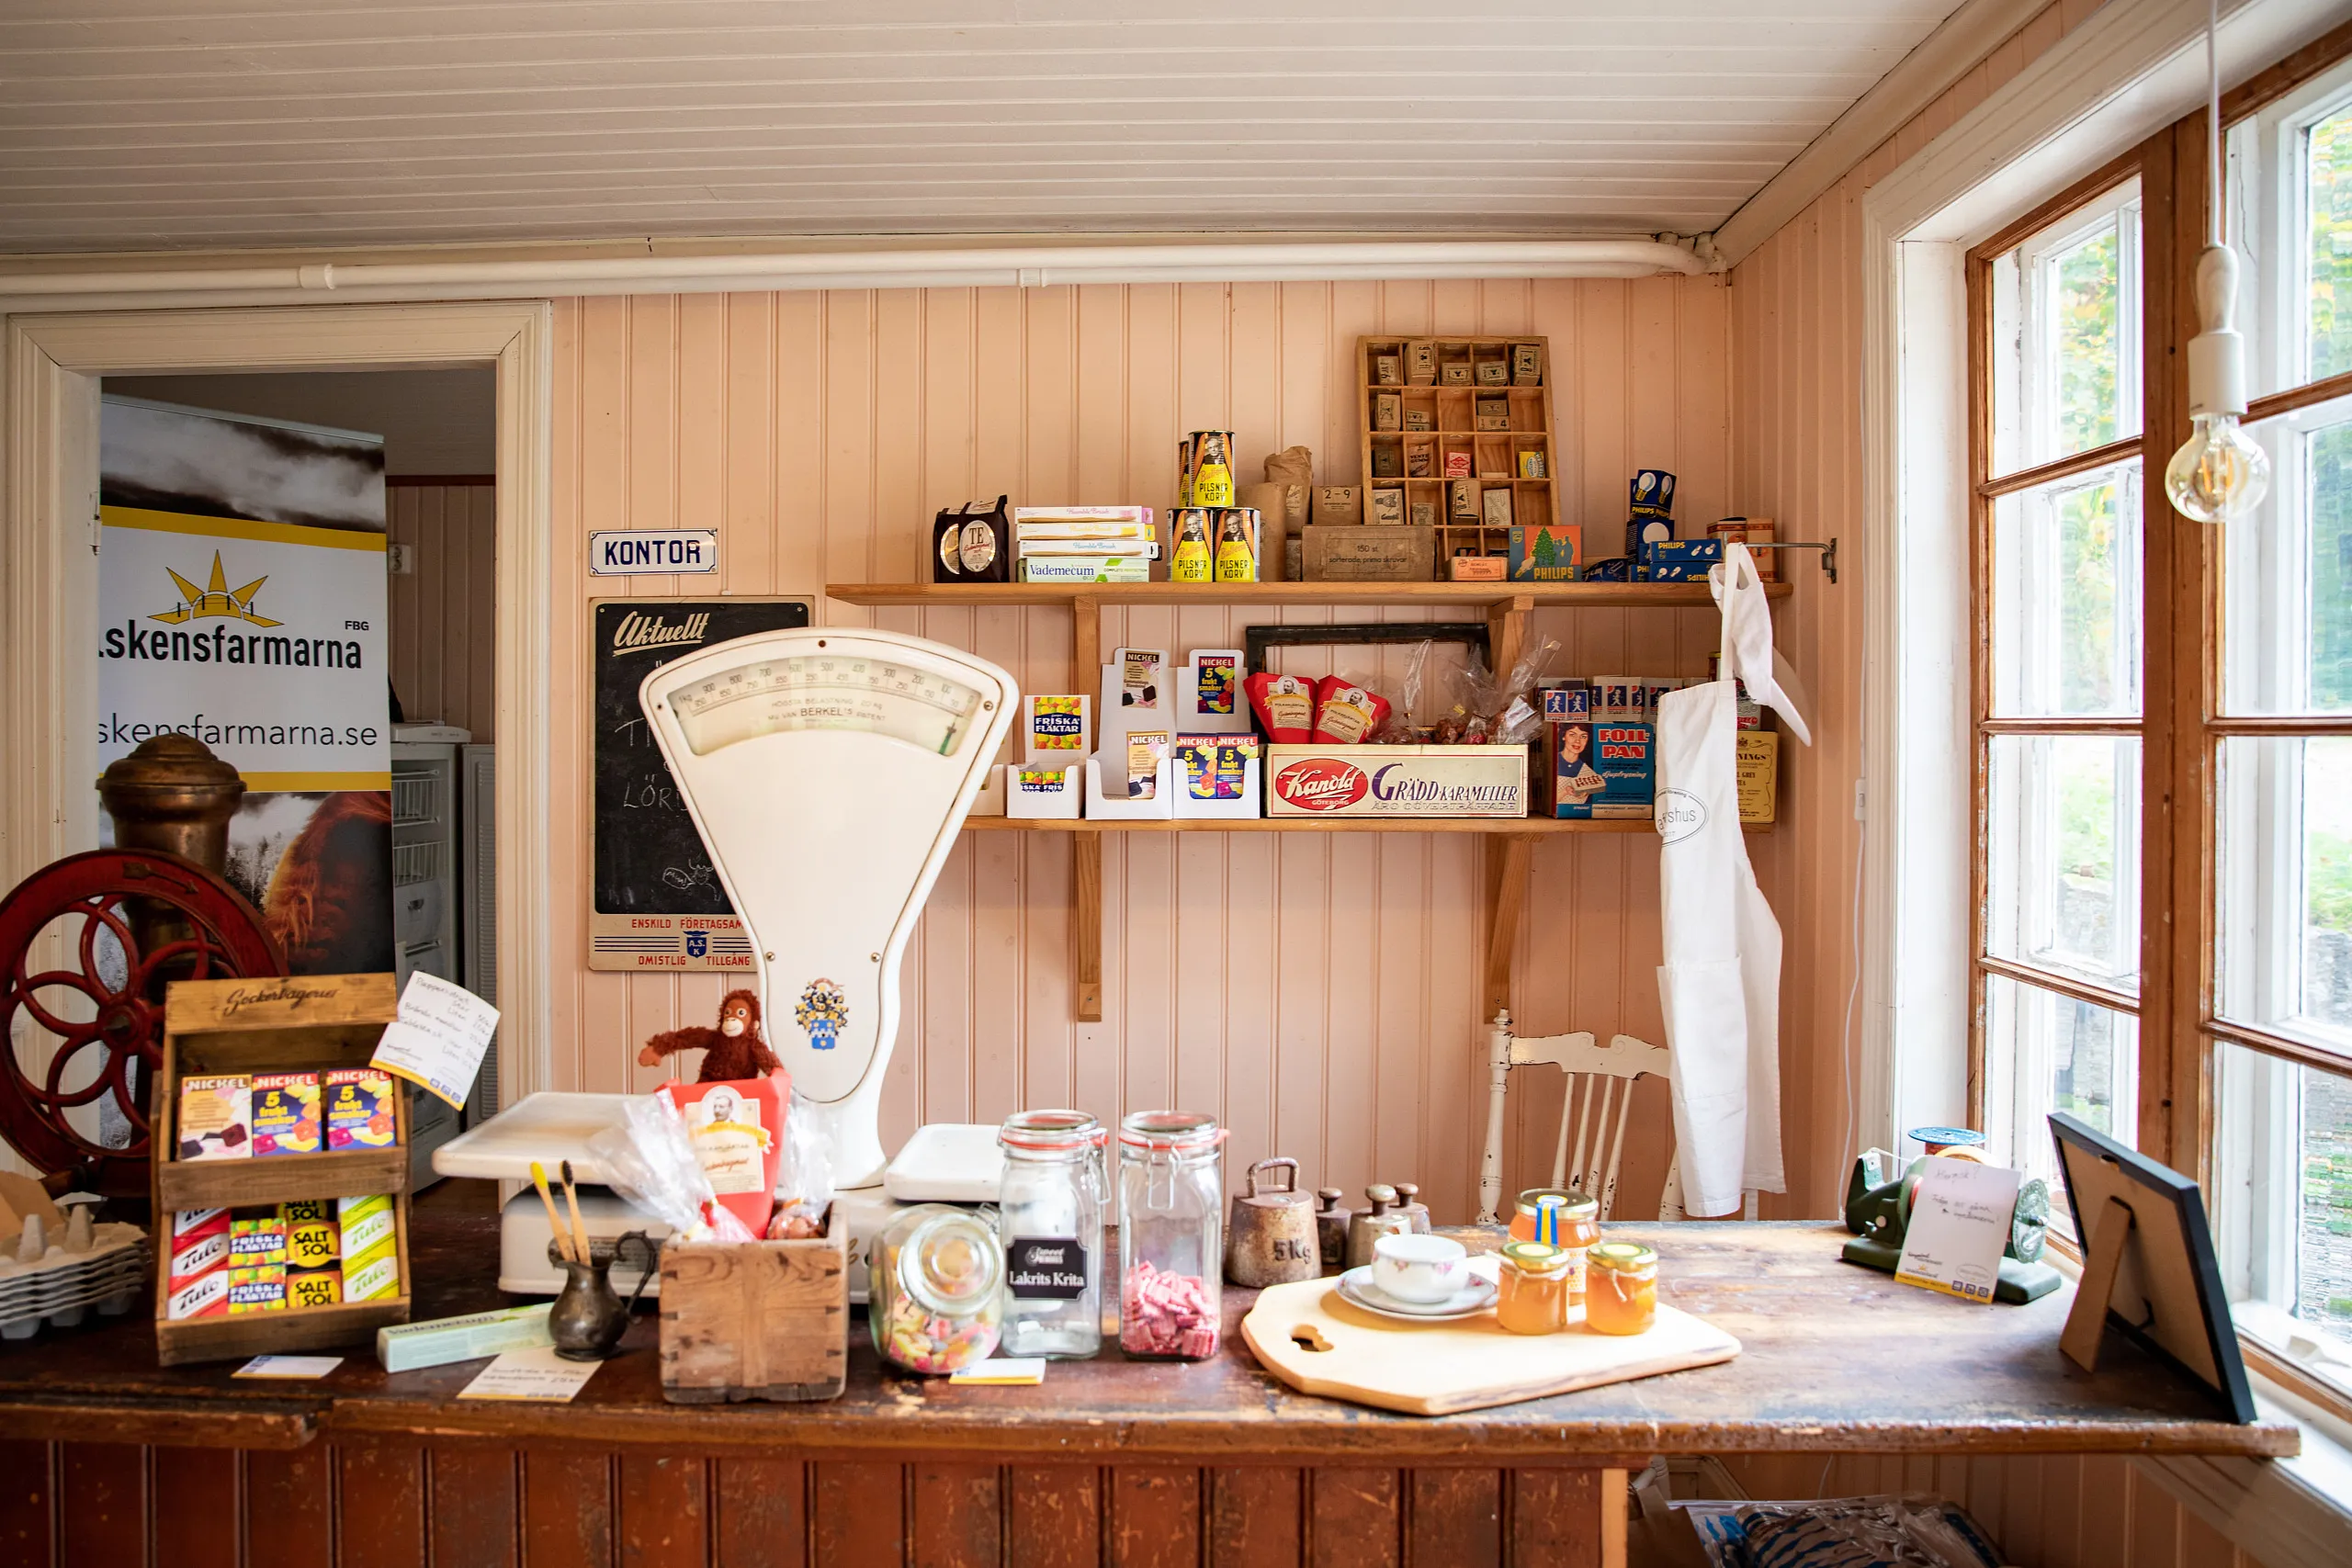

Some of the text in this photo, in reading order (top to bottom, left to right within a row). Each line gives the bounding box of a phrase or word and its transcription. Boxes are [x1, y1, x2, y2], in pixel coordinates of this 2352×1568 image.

[1200, 483, 1227, 492] PILSNER
[1205, 492, 1226, 502] KORV
[1325, 490, 1331, 499] 2
[1343, 490, 1351, 499] 9
[968, 527, 983, 544] TE
[605, 540, 700, 566] KONTOR
[1031, 564, 1093, 575] Vademecum
[1178, 560, 1207, 569] PILSNER
[1220, 560, 1248, 569] PILSNER
[1183, 570, 1204, 578] KORV
[1224, 570, 1244, 579] KORV
[1534, 567, 1574, 579] PHILIPS
[345, 621, 369, 630] FBG
[614, 611, 709, 647] Aktuellt
[98, 619, 362, 669] skensfarmarna
[759, 668, 772, 678] 700
[789, 663, 801, 672] 600
[821, 661, 833, 671] 500
[884, 668, 897, 678] 300
[911, 674, 924, 685] 200
[1205, 669, 1213, 678] 5
[1131, 736, 1166, 744] NICKEL
[1184, 750, 1193, 761] 5
[1226, 750, 1233, 761] 5
[1602, 746, 1645, 759] PAN
[1279, 766, 1361, 799] Kanold
[1372, 801, 1516, 810] ÄRO OÖVERTRÄFFADE
[632, 917, 744, 930] ENSKILD FÖRETAGSAM
[638, 952, 750, 966] OMISTLIG TILLGÅNG
[257, 1075, 312, 1088] NICKEL
[331, 1071, 388, 1082] NICKEL
[187, 1078, 246, 1090] NICKEL
[265, 1091, 280, 1106] 5
[340, 1086, 355, 1100] 5
[292, 1208, 322, 1220] SOL
[294, 1231, 329, 1244] SALT
[352, 1216, 386, 1246] Tulo
[184, 1241, 222, 1269] Tulo
[303, 1244, 333, 1256] SOL
[355, 1264, 390, 1294] Tulo
[1009, 1271, 1084, 1286] Lakrits Krita
[296, 1280, 331, 1294] SALT
[178, 1279, 220, 1310] Tulo
[305, 1293, 334, 1306] SOL
